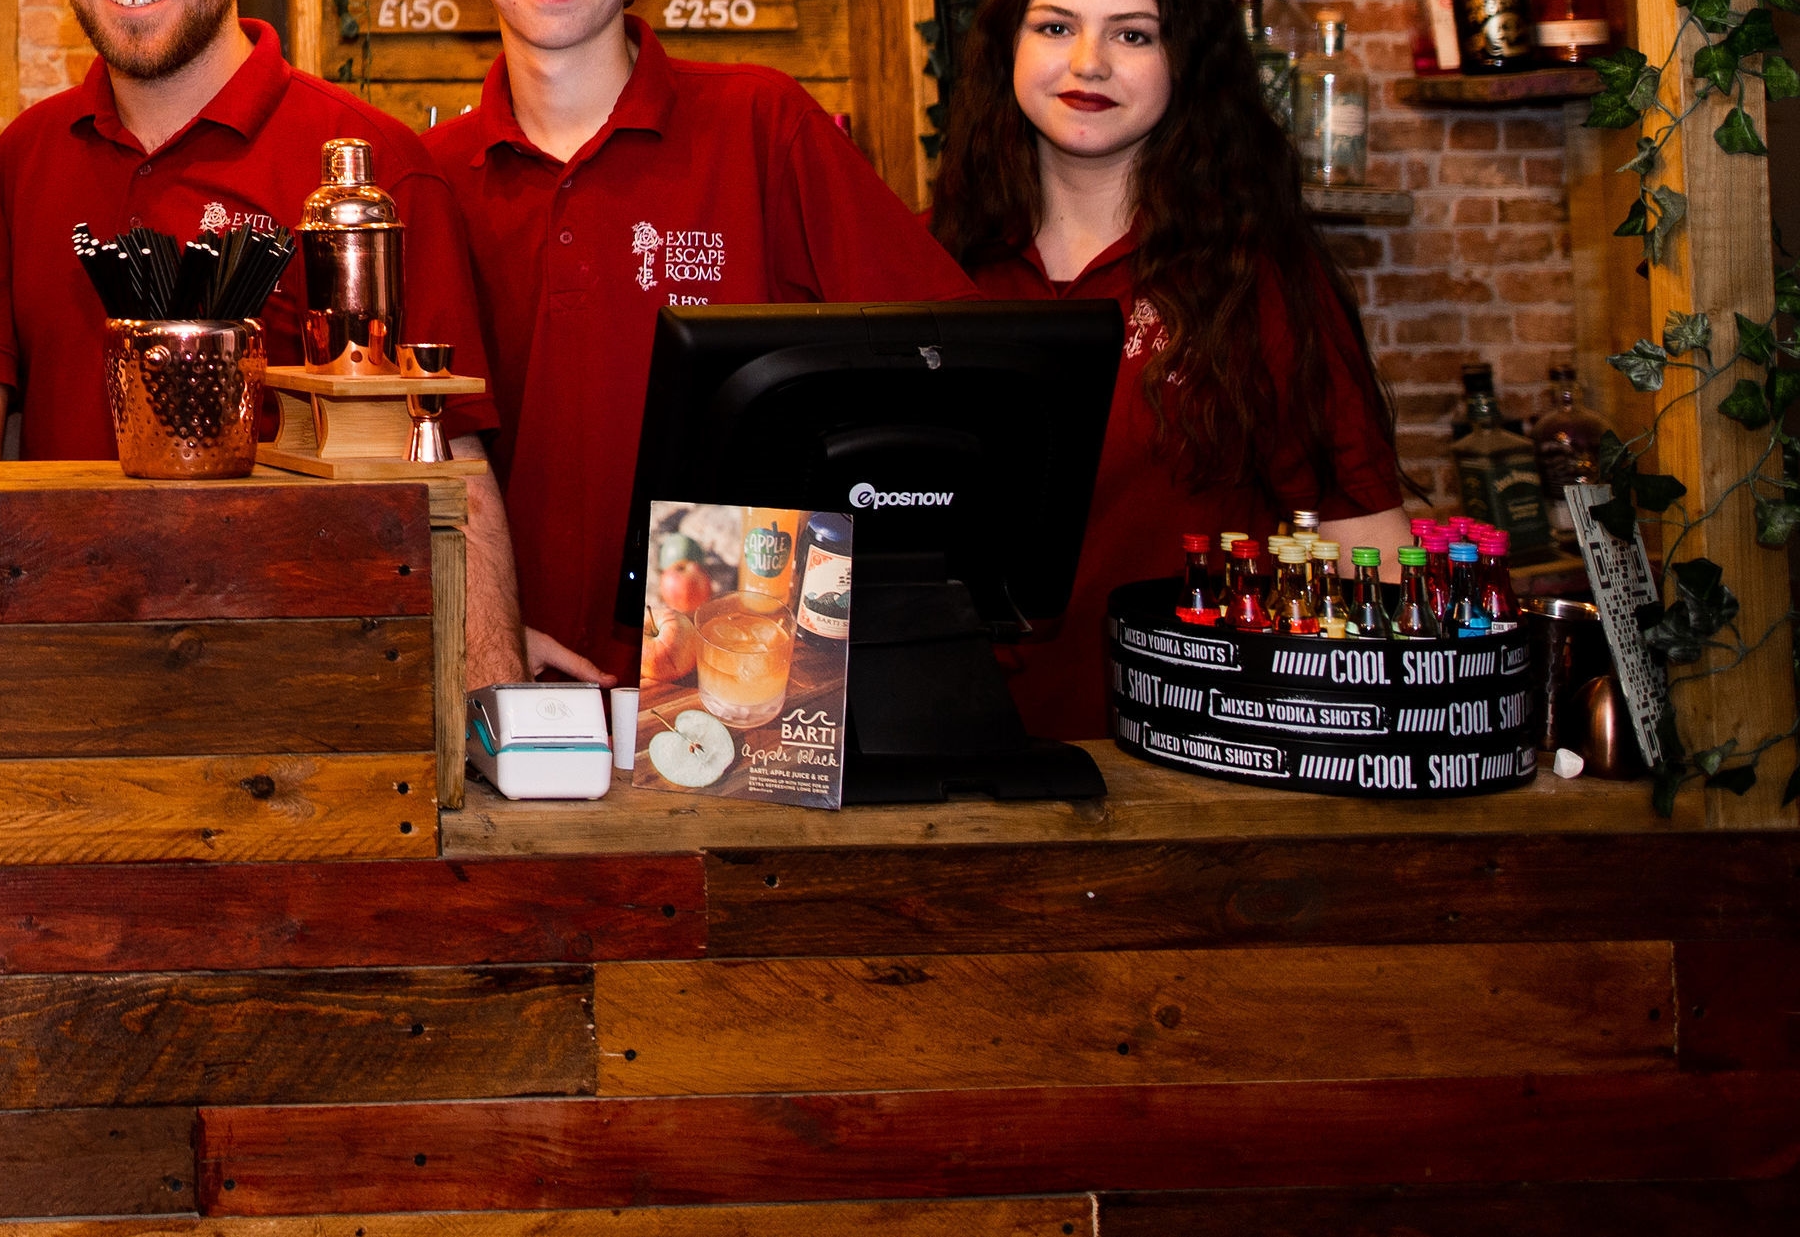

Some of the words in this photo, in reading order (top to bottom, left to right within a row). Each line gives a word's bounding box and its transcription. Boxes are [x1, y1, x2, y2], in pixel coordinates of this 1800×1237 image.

[232, 212, 278, 232] EXITU
[666, 231, 724, 248] EXITUS
[665, 247, 726, 265] ESCAPE
[665, 263, 721, 282] ROOMS
[749, 533, 786, 554] APPLE
[751, 553, 786, 571] JUICE
[1124, 627, 1146, 650] MIXED
[1149, 634, 1180, 655] VODKA
[1184, 642, 1226, 663] SHOTS
[1330, 649, 1391, 684] COOL
[1403, 650, 1457, 684] SHOT
[1128, 668, 1161, 708] SHOT
[1221, 697, 1264, 718] MIXED
[1267, 704, 1316, 724] VODKA
[1320, 708, 1372, 727] SHOTS
[1450, 700, 1492, 736] COOL
[1499, 691, 1526, 730] SHOT
[781, 723, 836, 744] BARTI
[797, 748, 839, 767] Black
[1150, 731, 1180, 752] MIXED
[1183, 739, 1222, 762] VODKA
[1225, 748, 1273, 770] SHOTS
[1358, 754, 1417, 789] COOL
[1429, 753, 1480, 789] SHOT
